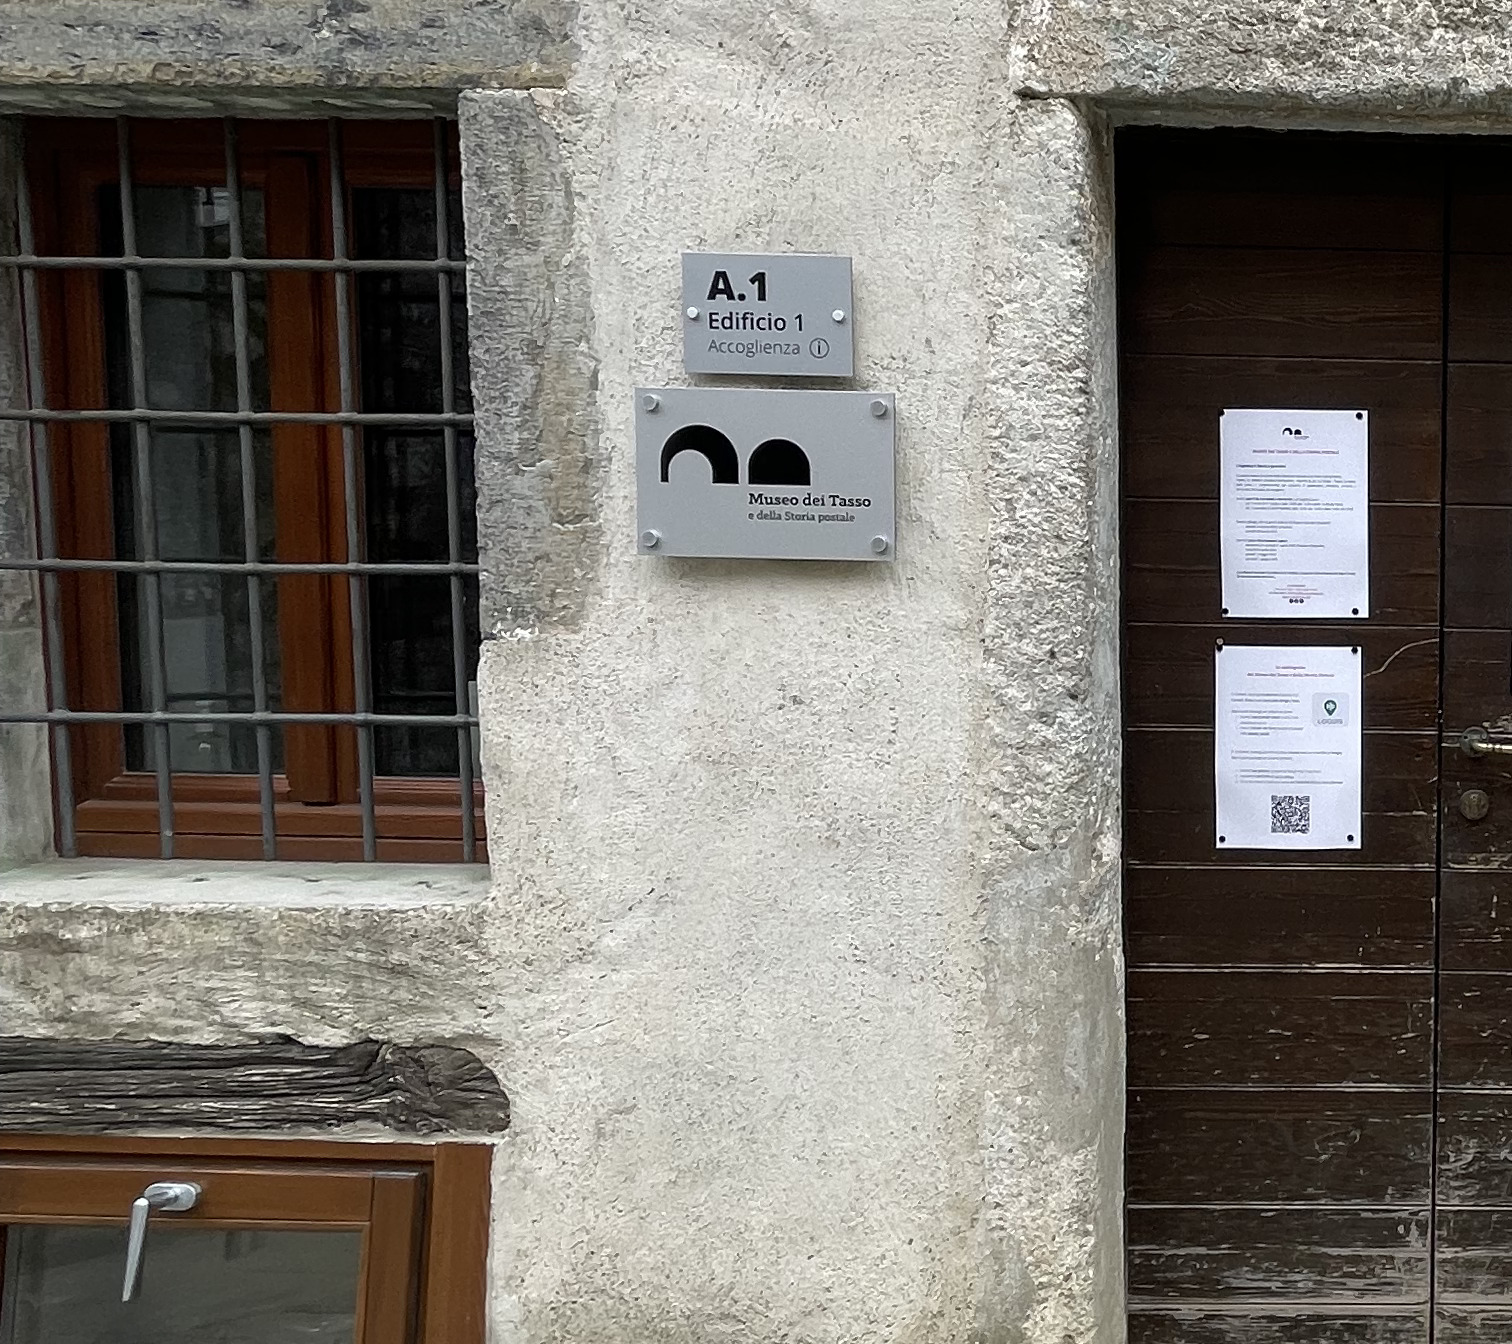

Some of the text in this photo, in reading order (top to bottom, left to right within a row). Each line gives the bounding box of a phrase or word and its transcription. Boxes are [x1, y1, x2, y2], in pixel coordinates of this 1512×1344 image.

[706, 270, 767, 302] A.1
[708, 311, 803, 332] Edificio 1
[707, 339, 801, 358] Accoglienza
[748, 492, 872, 508] Museo dei Tasso
[748, 510, 856, 524] e della Storia postale
